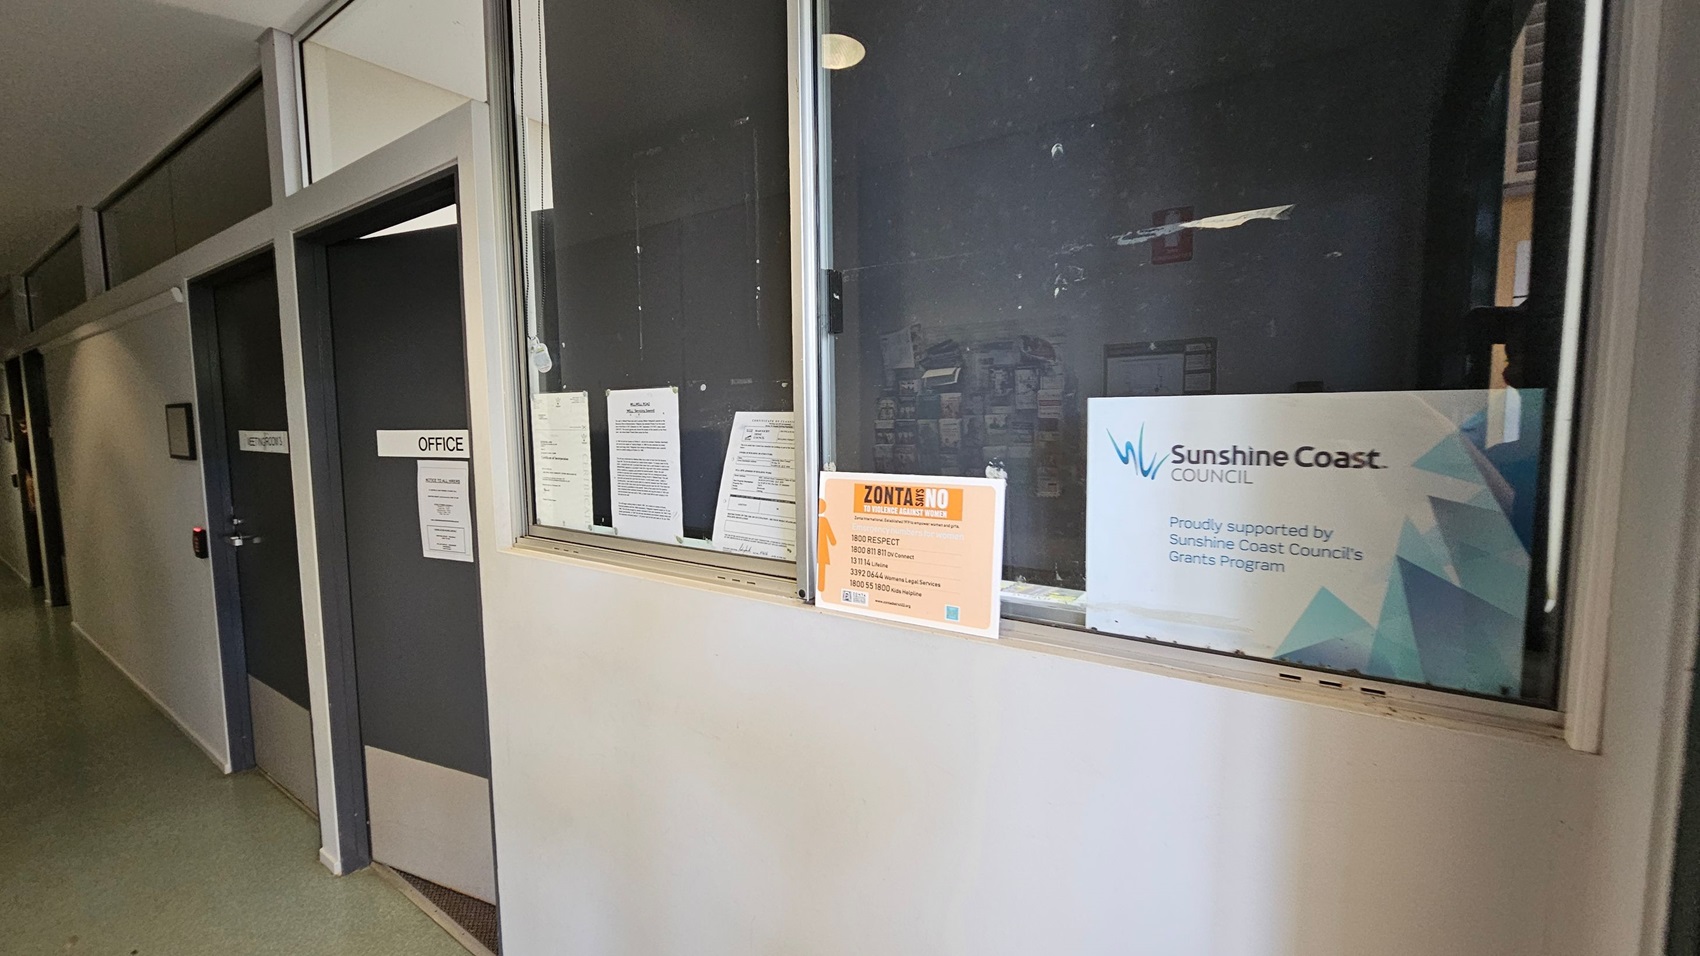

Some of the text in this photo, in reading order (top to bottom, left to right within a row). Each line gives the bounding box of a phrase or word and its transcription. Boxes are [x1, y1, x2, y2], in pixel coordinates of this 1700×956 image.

[418, 436, 464, 452] OFFICE
[1171, 444, 1381, 469] Sunshine Coast
[1171, 468, 1254, 484] COUNCIL
[864, 485, 948, 509] ZONTA SAYS NO
[872, 506, 898, 515] VIOLENCE
[899, 508, 923, 516] AGAINST
[924, 510, 948, 518] WOMEN
[1170, 516, 1334, 543] Proudly supported by
[851, 534, 900, 546] 1800 RESPECT
[1169, 534, 1364, 561] Sunshine Coast Council's
[851, 546, 866, 554] 1800
[1169, 550, 1285, 572] Grants Program
[850, 568, 866, 577] 3392
[866, 570, 883, 579] 0644
[884, 574, 904, 582] Womens
[850, 579, 864, 588] 1800
[875, 583, 890, 592] 1800
